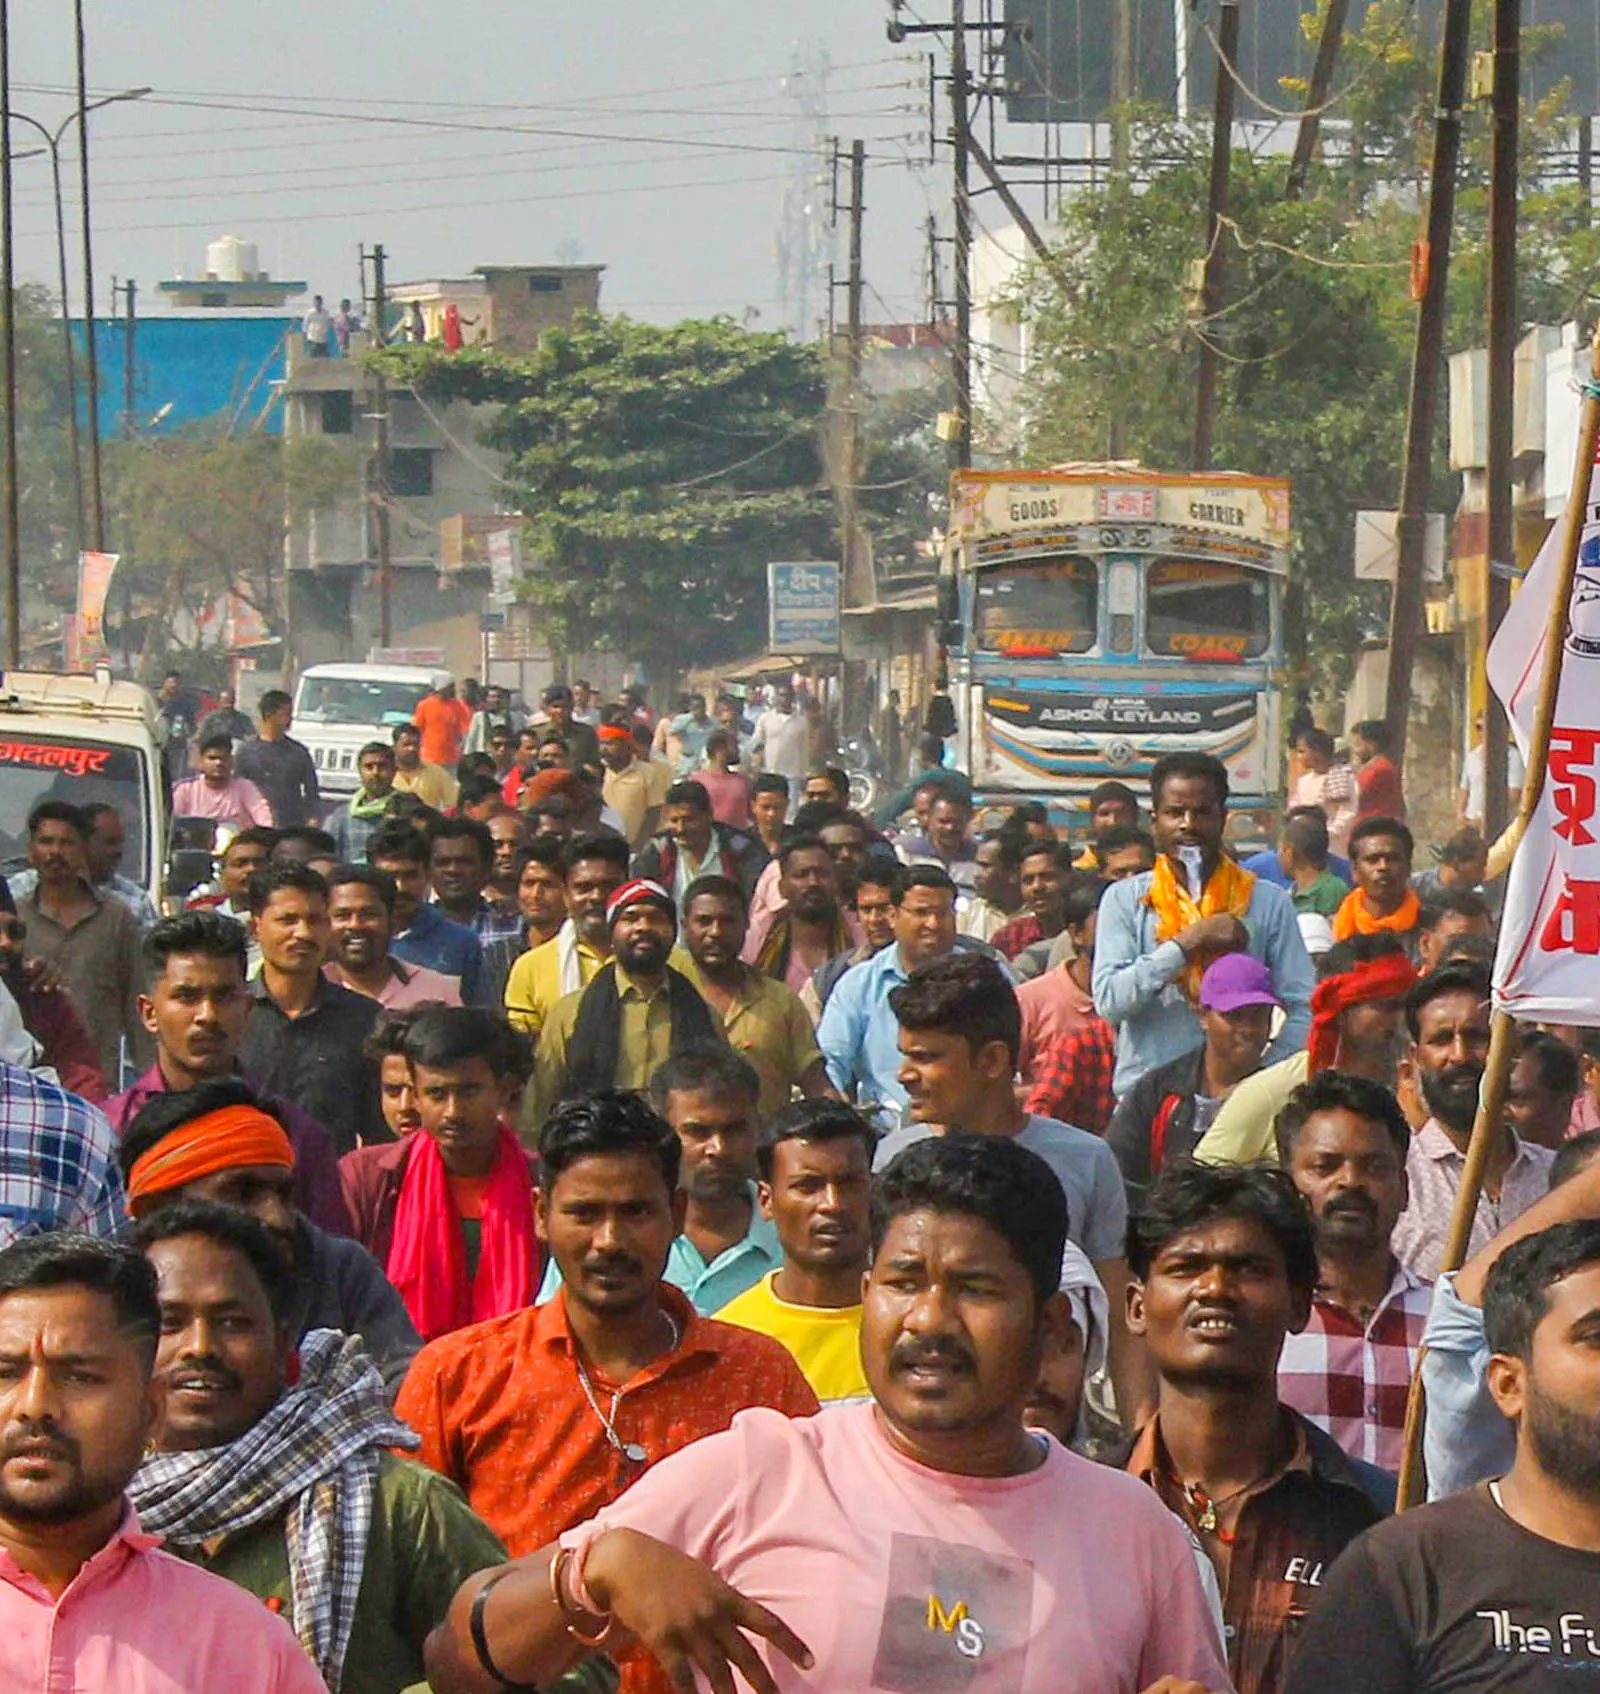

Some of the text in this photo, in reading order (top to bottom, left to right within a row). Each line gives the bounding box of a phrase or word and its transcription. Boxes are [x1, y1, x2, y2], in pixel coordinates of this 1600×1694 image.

[1010, 498, 1059, 521] GOODS
[1039, 708, 1201, 724] ASHOK LEYLAND
[1476, 1610, 1552, 1654] The
